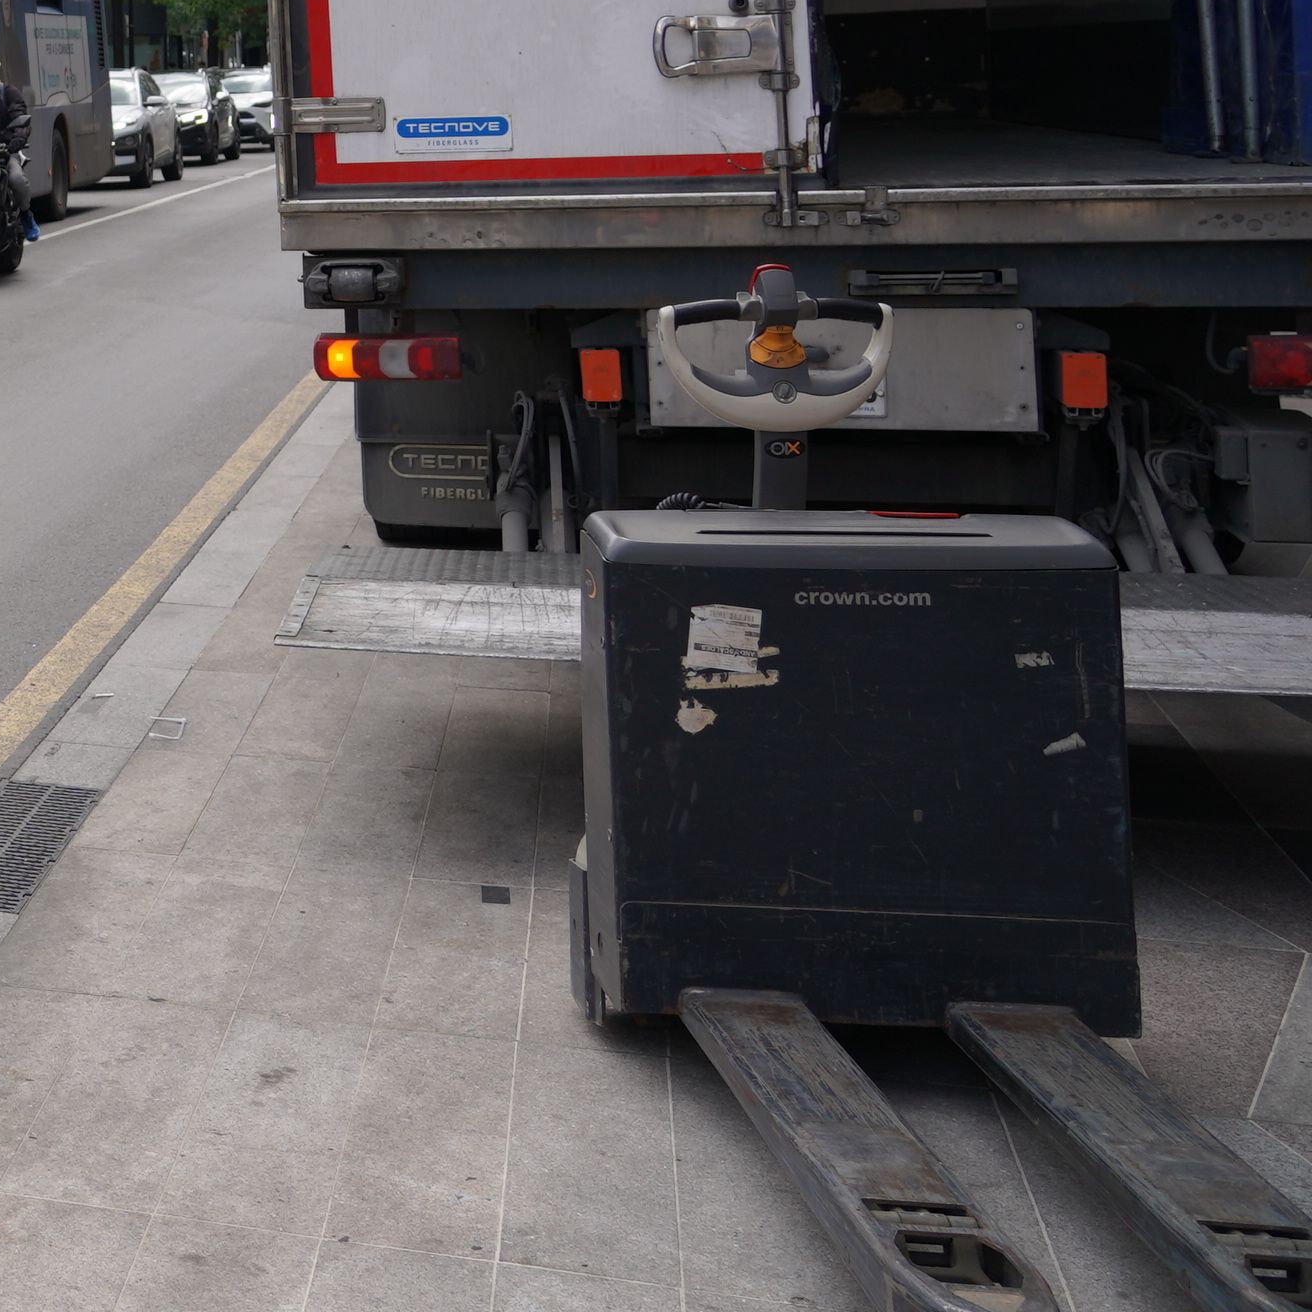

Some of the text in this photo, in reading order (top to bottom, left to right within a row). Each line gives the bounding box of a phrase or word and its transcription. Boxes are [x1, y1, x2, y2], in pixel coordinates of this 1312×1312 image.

[405, 121, 501, 134] TECNOVE
[427, 139, 480, 147] FIBERGLASS
[403, 453, 488, 470] TECNO
[421, 487, 490, 500] FIBERGL
[794, 590, 932, 606] crown.com
